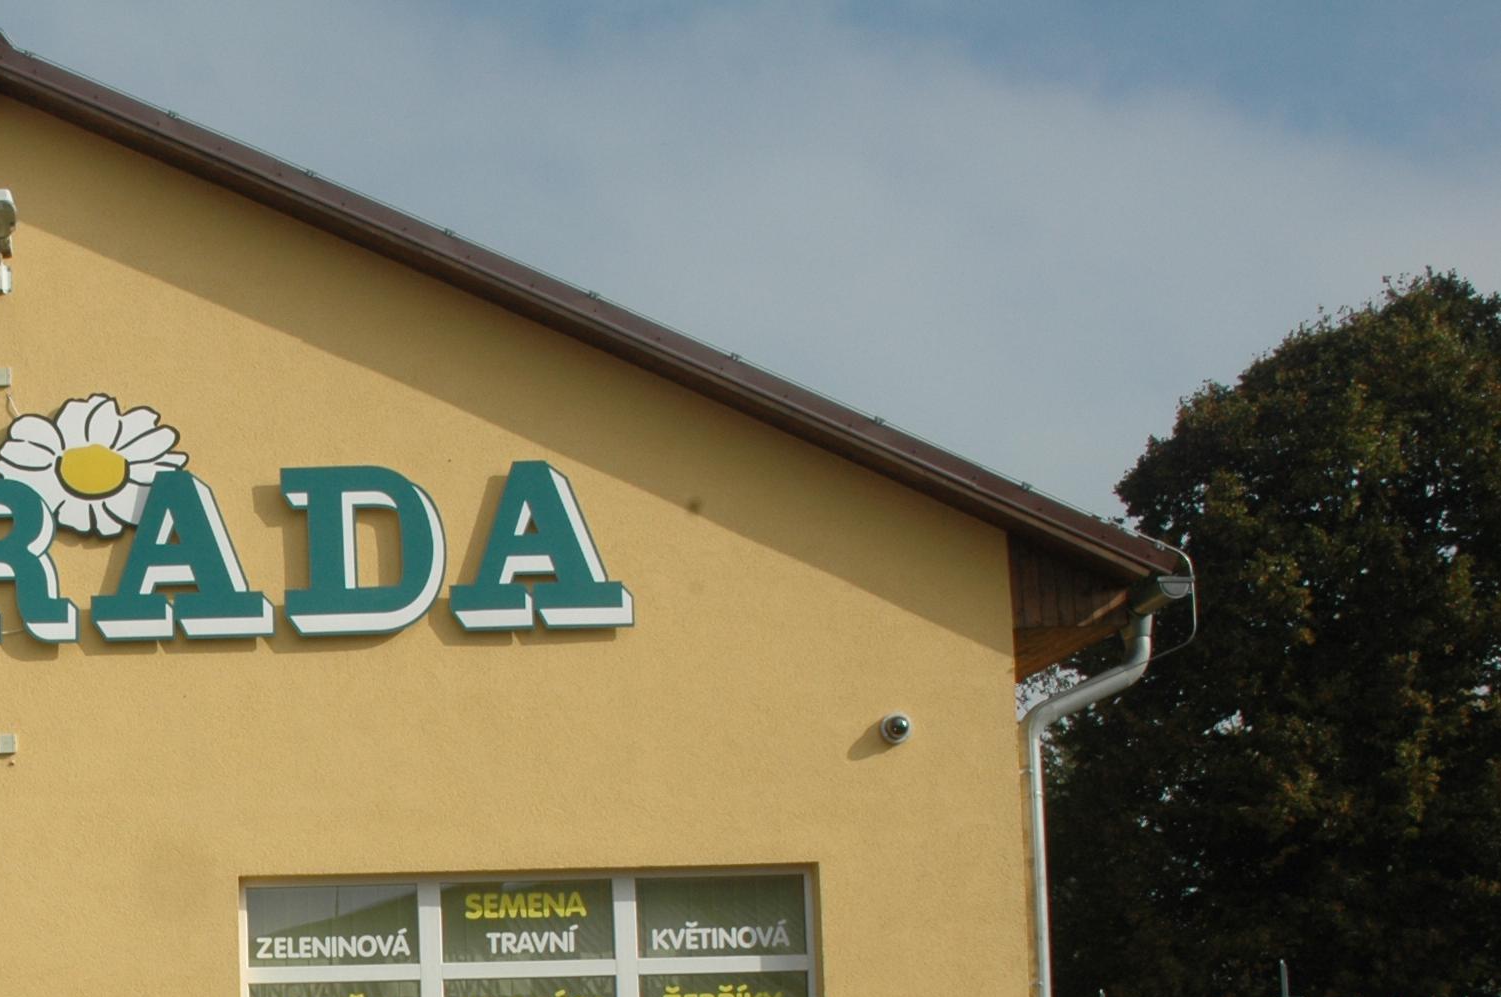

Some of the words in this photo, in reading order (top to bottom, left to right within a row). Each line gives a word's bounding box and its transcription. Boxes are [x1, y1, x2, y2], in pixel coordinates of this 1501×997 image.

[464, 891, 587, 920] SEMENA
[256, 929, 412, 960] ZELENINOVÁ
[486, 925, 579, 956] TRAVNÍ
[651, 919, 791, 952] KVĚTINOVÁ
